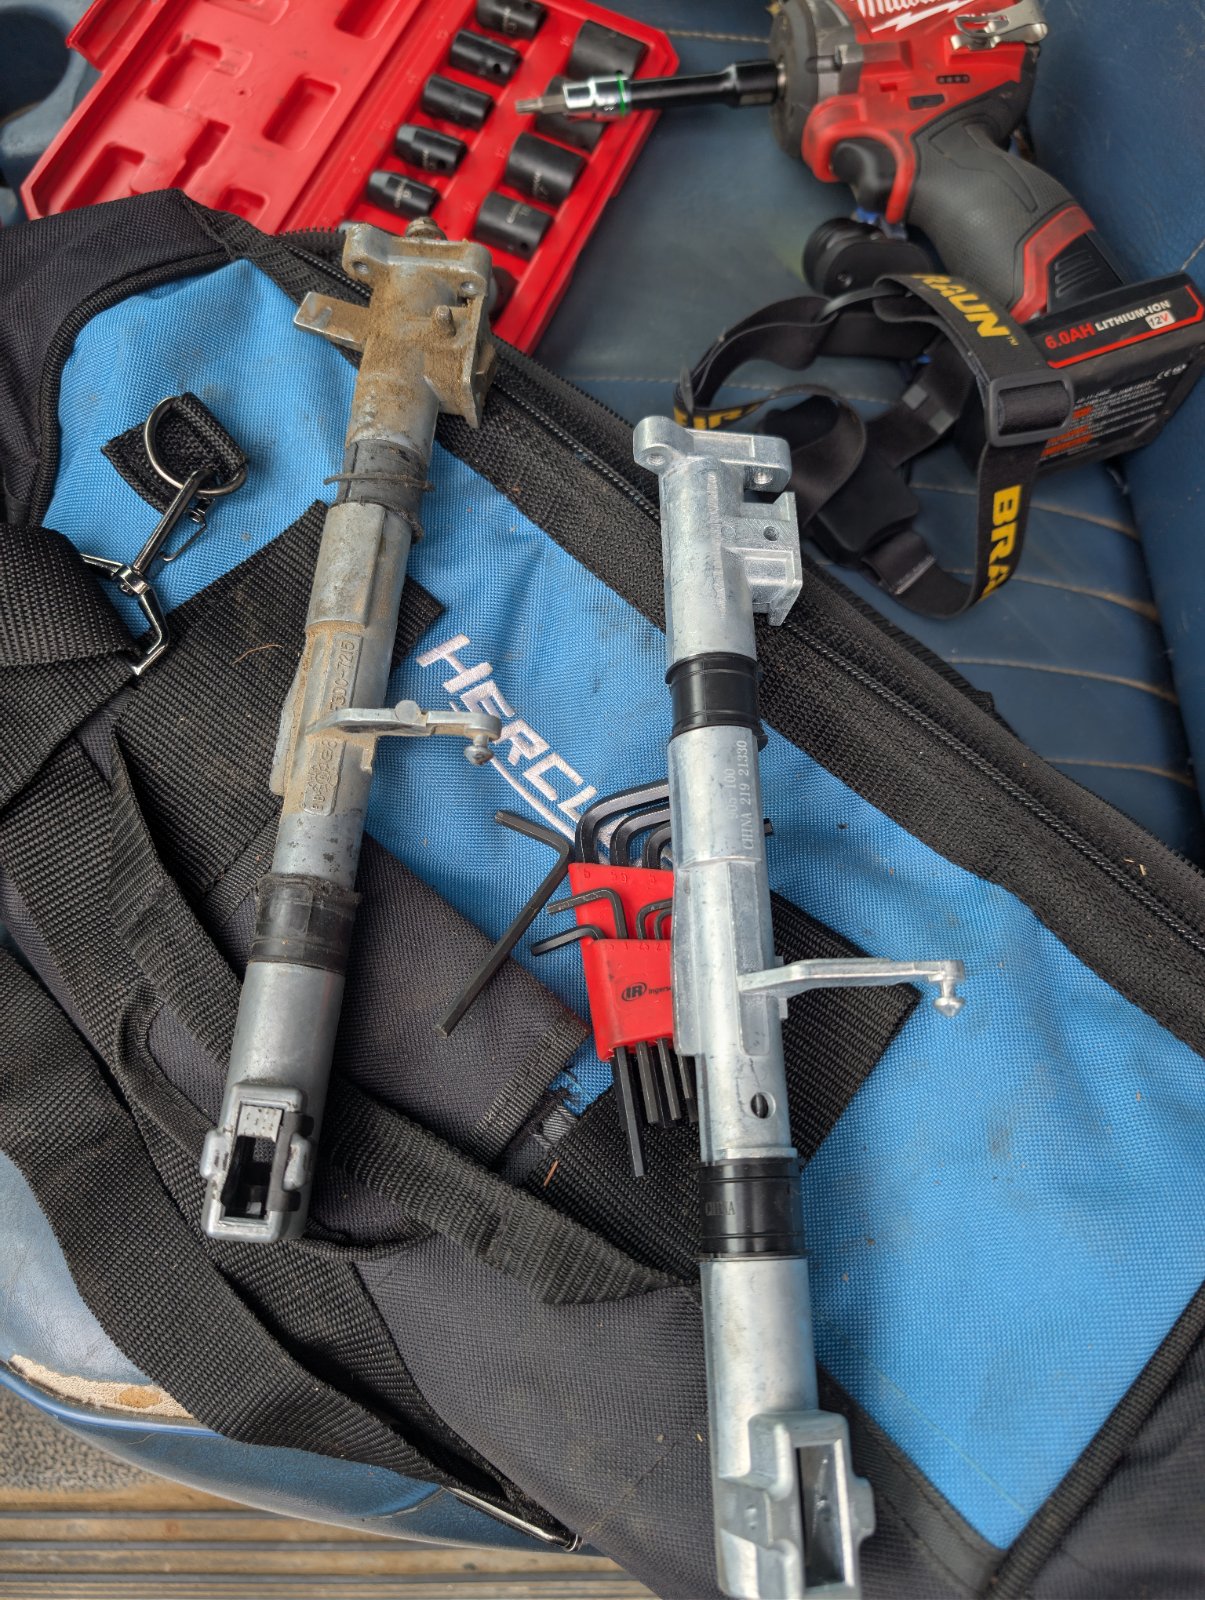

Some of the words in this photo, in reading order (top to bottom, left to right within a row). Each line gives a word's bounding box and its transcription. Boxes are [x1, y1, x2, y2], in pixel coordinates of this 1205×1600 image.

[912, 274, 1010, 337] RAUN
[1045, 322, 1096, 349] 6.0AH
[1095, 300, 1171, 332] LITHIUM-ION
[1148, 312, 1171, 327] 12V
[982, 484, 1022, 600] BRA
[736, 740, 749, 776] 21330
[739, 783, 751, 805] 219
[741, 812, 754, 850] CHINA
